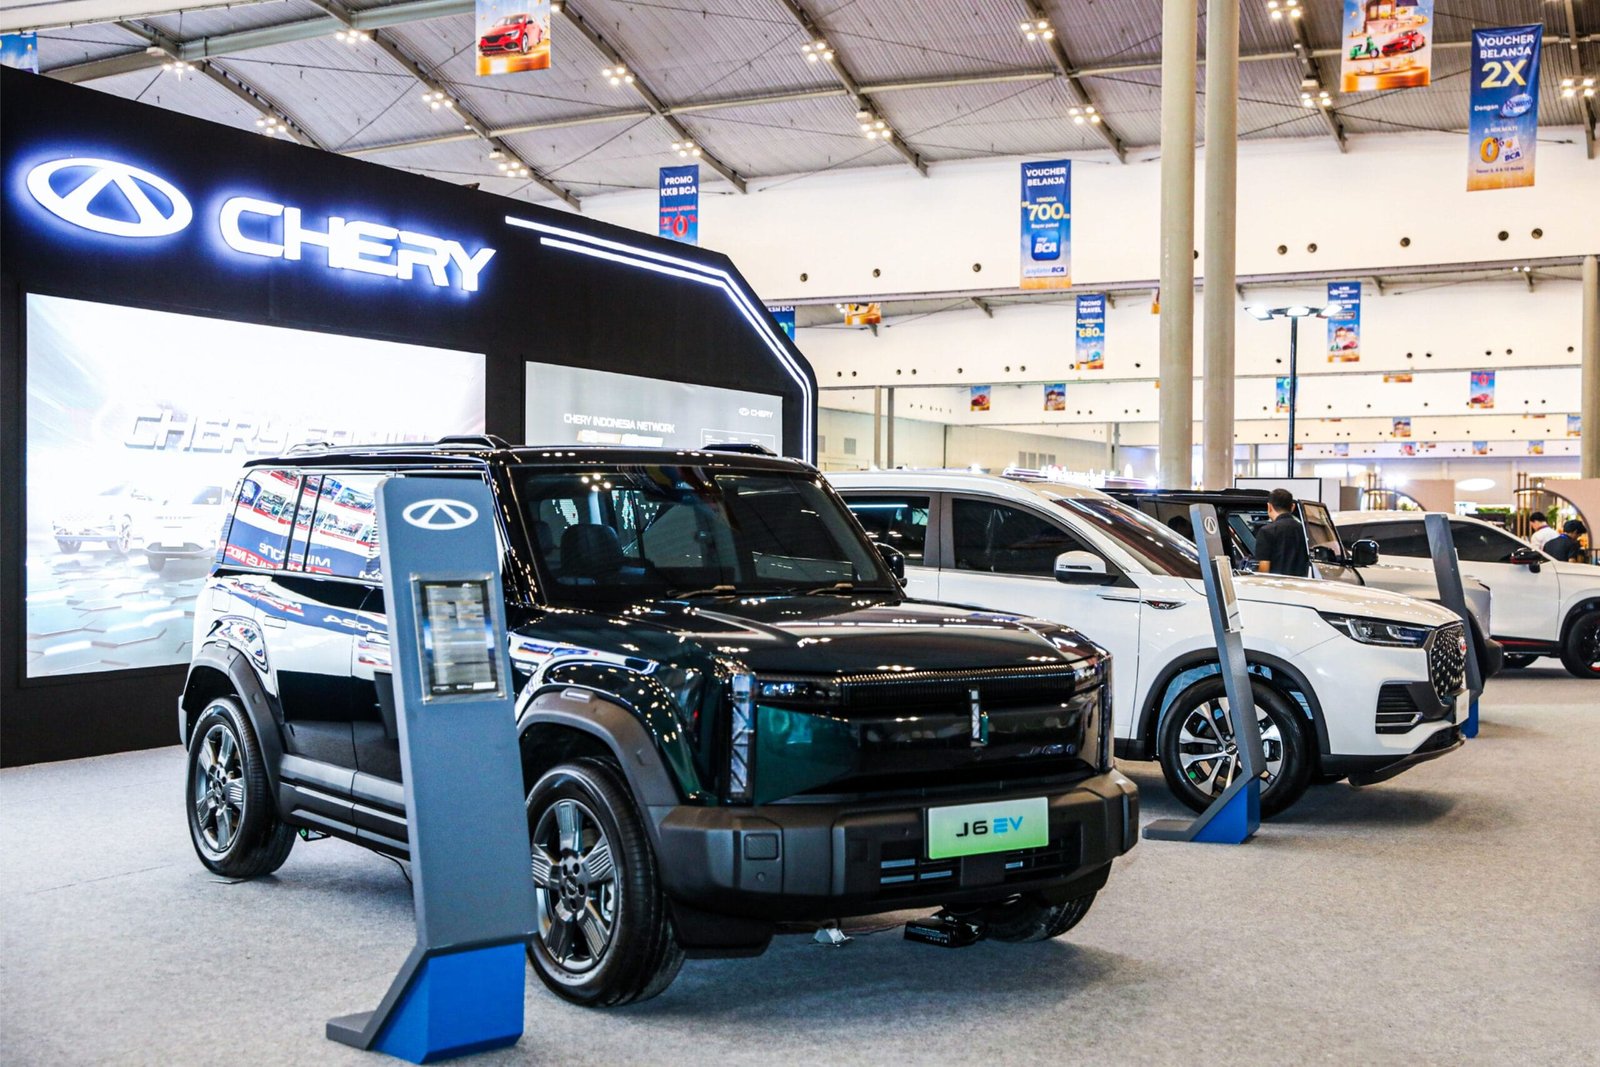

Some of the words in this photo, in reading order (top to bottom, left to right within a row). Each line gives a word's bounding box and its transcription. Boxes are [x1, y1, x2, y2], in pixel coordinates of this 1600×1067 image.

[1479, 34, 1534, 47] VOUCHER
[1480, 46, 1532, 58] BELANJA
[1480, 59, 1527, 89] 2X
[1474, 104, 1499, 112] Dengan
[1504, 151, 1521, 162] BCA
[1026, 167, 1066, 177] VOUCHER
[665, 175, 693, 186] PROMO
[1027, 177, 1065, 187] BELANJA
[661, 187, 678, 197] KKB
[679, 185, 697, 195] BCA
[1028, 202, 1064, 222] 700
[219, 196, 497, 292] CHERY
[1034, 242, 1057, 253] BCA
[751, 409, 774, 419] CHERY
[563, 413, 592, 426] CHERY
[592, 415, 636, 430] INDONESIA
[636, 420, 675, 434] NETWORK
[956, 820, 988, 837] J6
[993, 816, 1023, 833] EV
